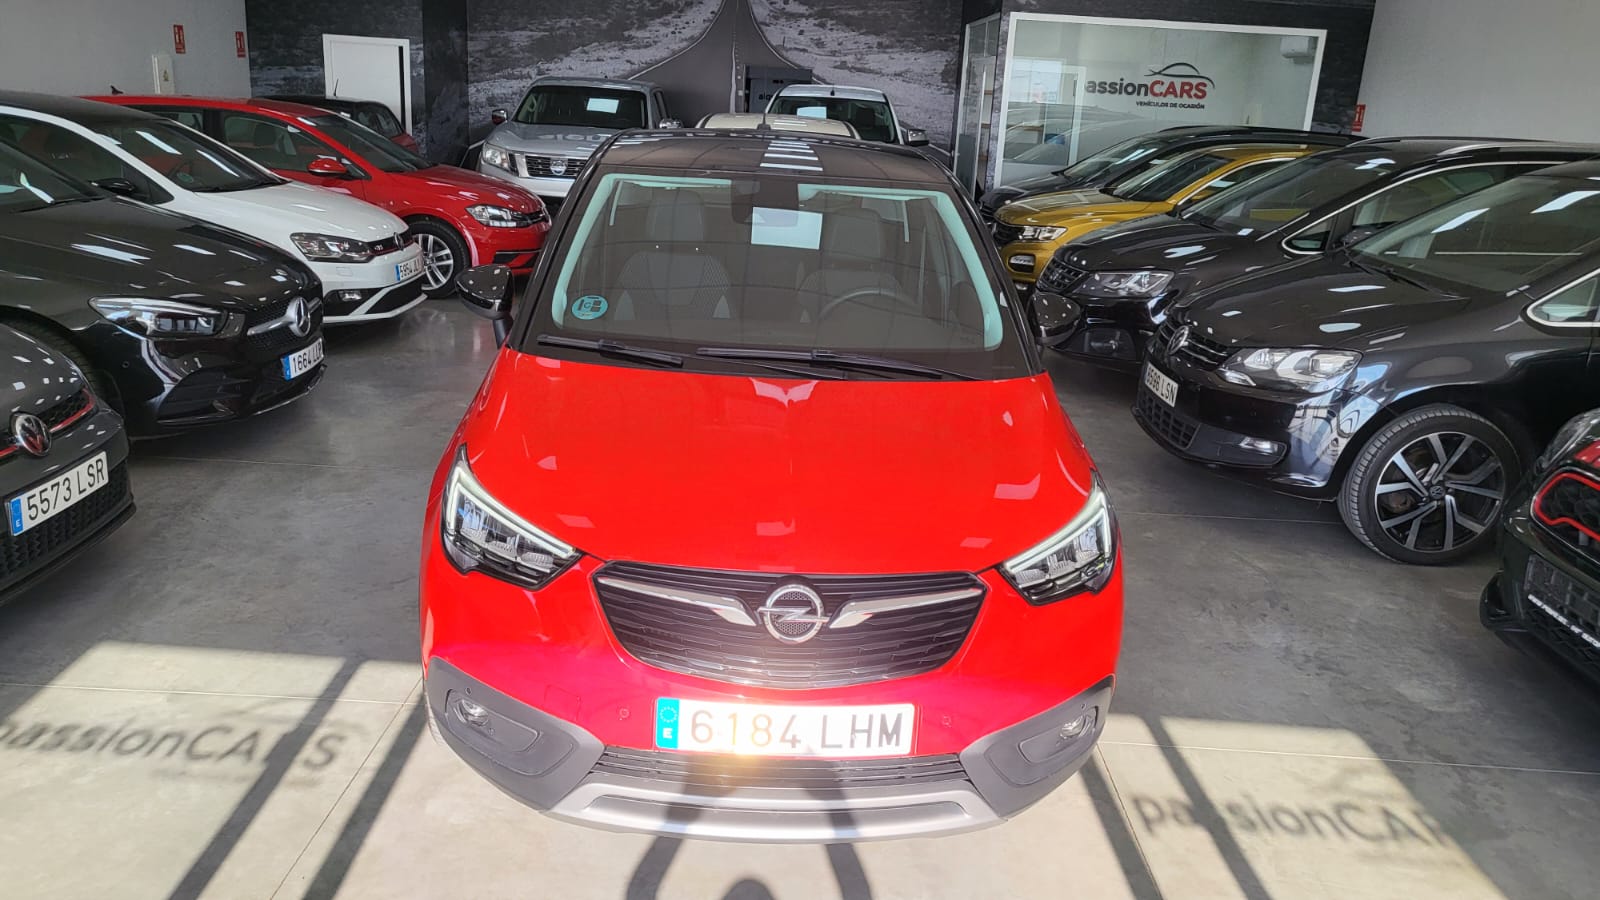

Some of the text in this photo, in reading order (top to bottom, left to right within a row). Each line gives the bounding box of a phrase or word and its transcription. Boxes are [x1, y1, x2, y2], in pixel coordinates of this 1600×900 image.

[1086, 78, 1208, 99] assionCARS
[292, 350, 312, 374] 1664
[26, 458, 105, 521] 5573 LSR
[662, 727, 673, 739] E
[690, 709, 903, 749] 6184 LHM
